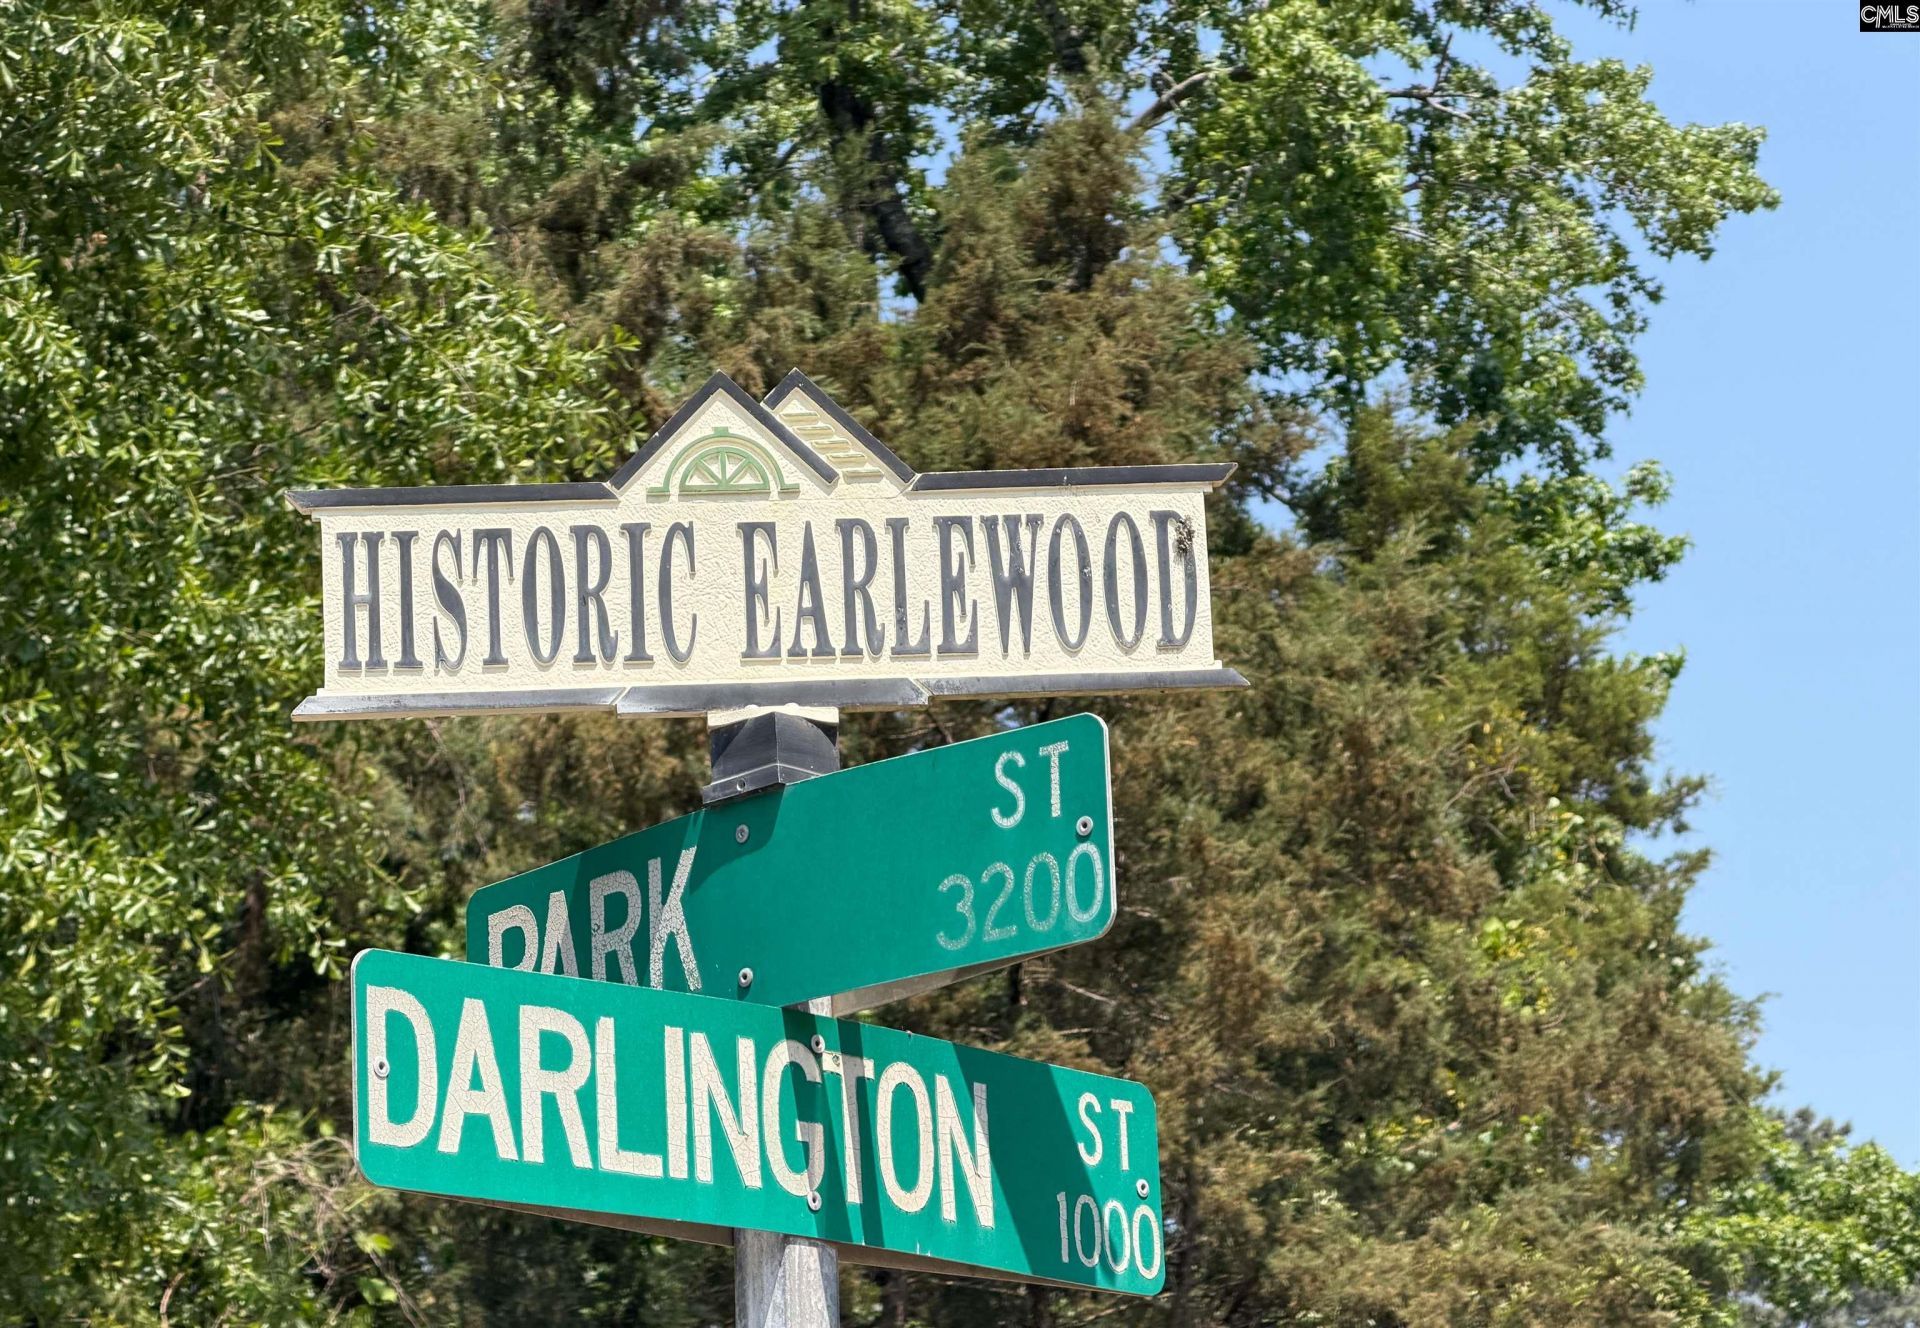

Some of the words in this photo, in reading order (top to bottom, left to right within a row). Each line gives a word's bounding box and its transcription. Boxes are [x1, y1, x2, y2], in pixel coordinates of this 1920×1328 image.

[336, 521, 698, 671] HISTORIC
[736, 510, 1199, 660] EARLEWOOD
[488, 846, 702, 991] PARK
[991, 740, 1069, 828] ST
[936, 841, 1104, 950] 3200
[366, 984, 995, 1229] DARLINGTON
[1077, 1092, 1134, 1171] ST
[1056, 1191, 1161, 1280] 1000
